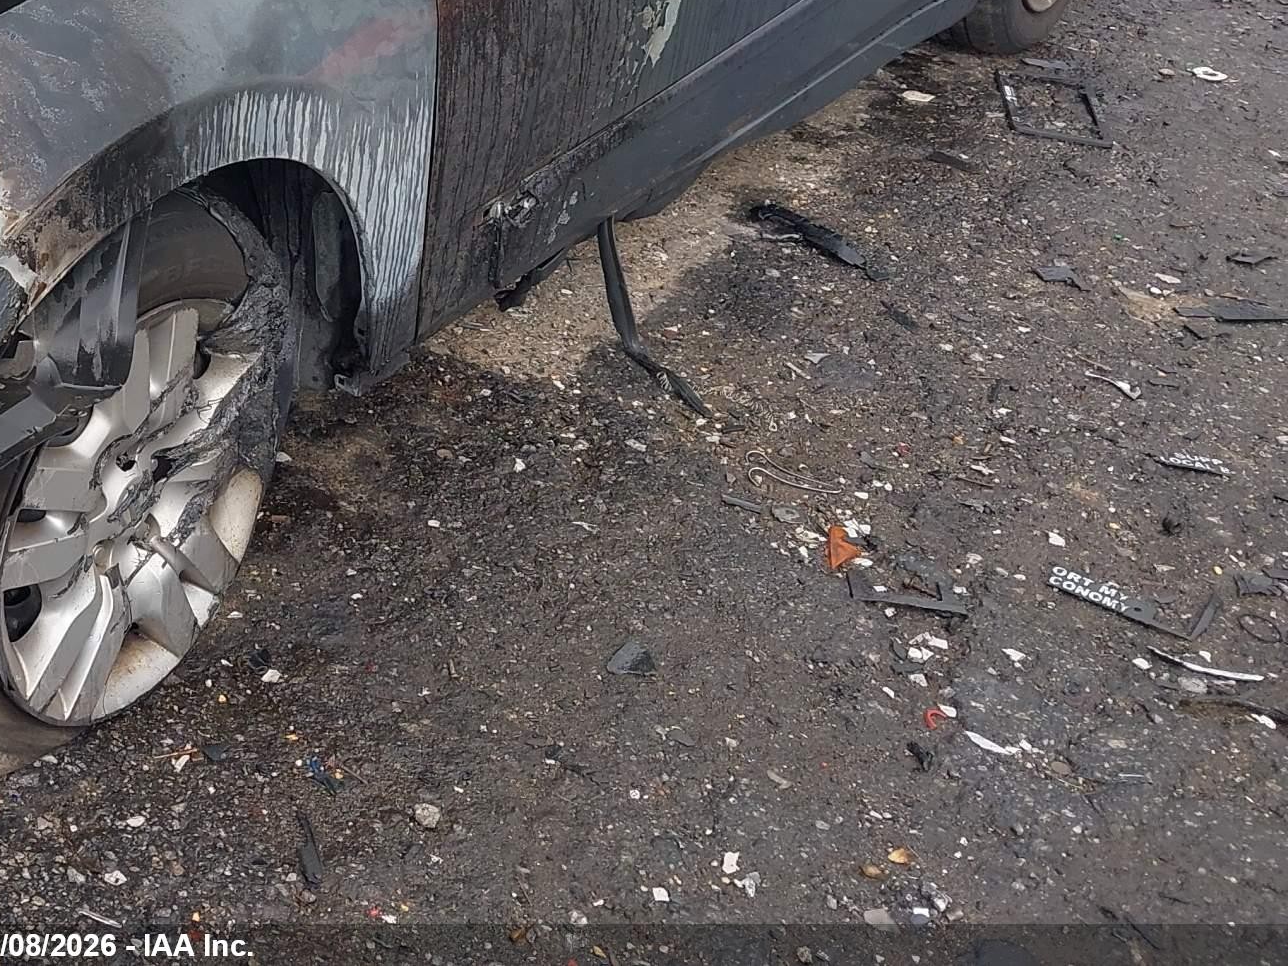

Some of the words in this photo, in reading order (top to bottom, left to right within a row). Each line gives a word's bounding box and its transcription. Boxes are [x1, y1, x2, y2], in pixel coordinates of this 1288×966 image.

[1049, 576, 1129, 612] CONOMY
[1052, 566, 1095, 586] ORT
[1098, 585, 1129, 602] MY
